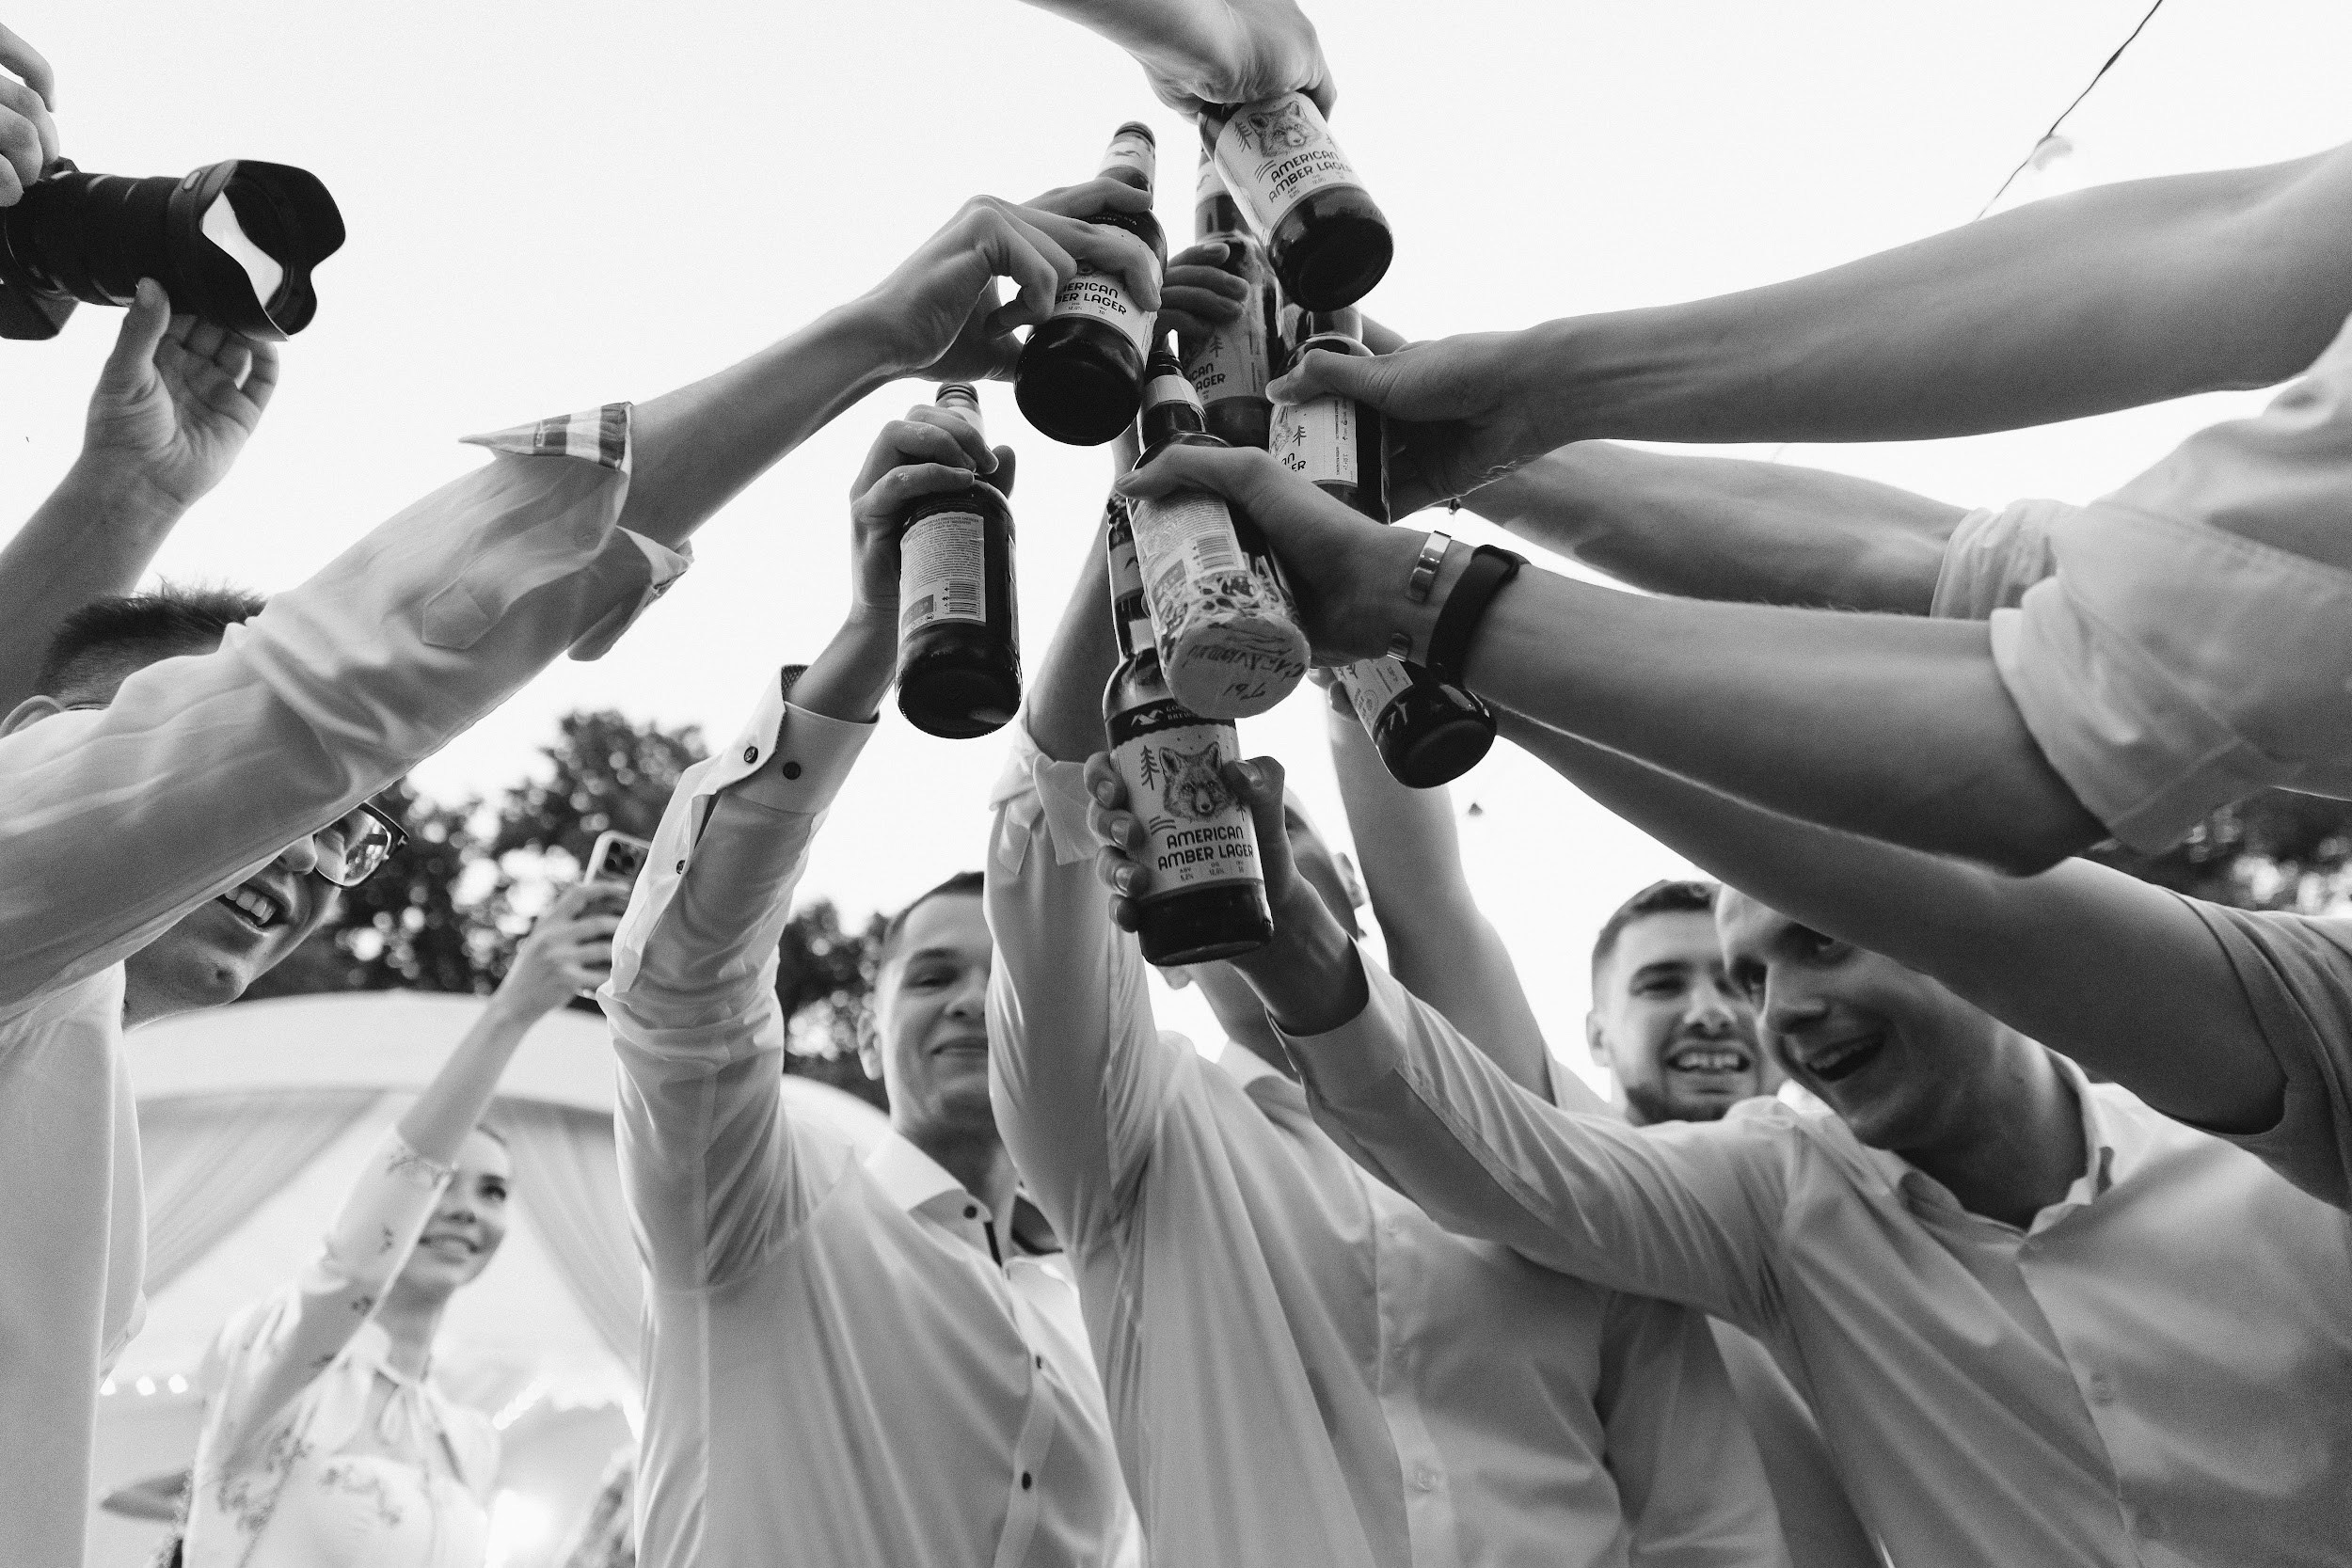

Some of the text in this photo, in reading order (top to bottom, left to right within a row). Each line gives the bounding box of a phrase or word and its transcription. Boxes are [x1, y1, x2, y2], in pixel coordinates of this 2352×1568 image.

[1270, 150, 1340, 183] AMERICAN
[1268, 166, 1313, 203] AMBER
[1063, 282, 1118, 299] ERICAN
[1083, 293, 1127, 315] LAGER
[1196, 373, 1226, 392] AGER
[1167, 826, 1244, 849] AMERICAN
[1158, 844, 1254, 871] AMBER LAGER
